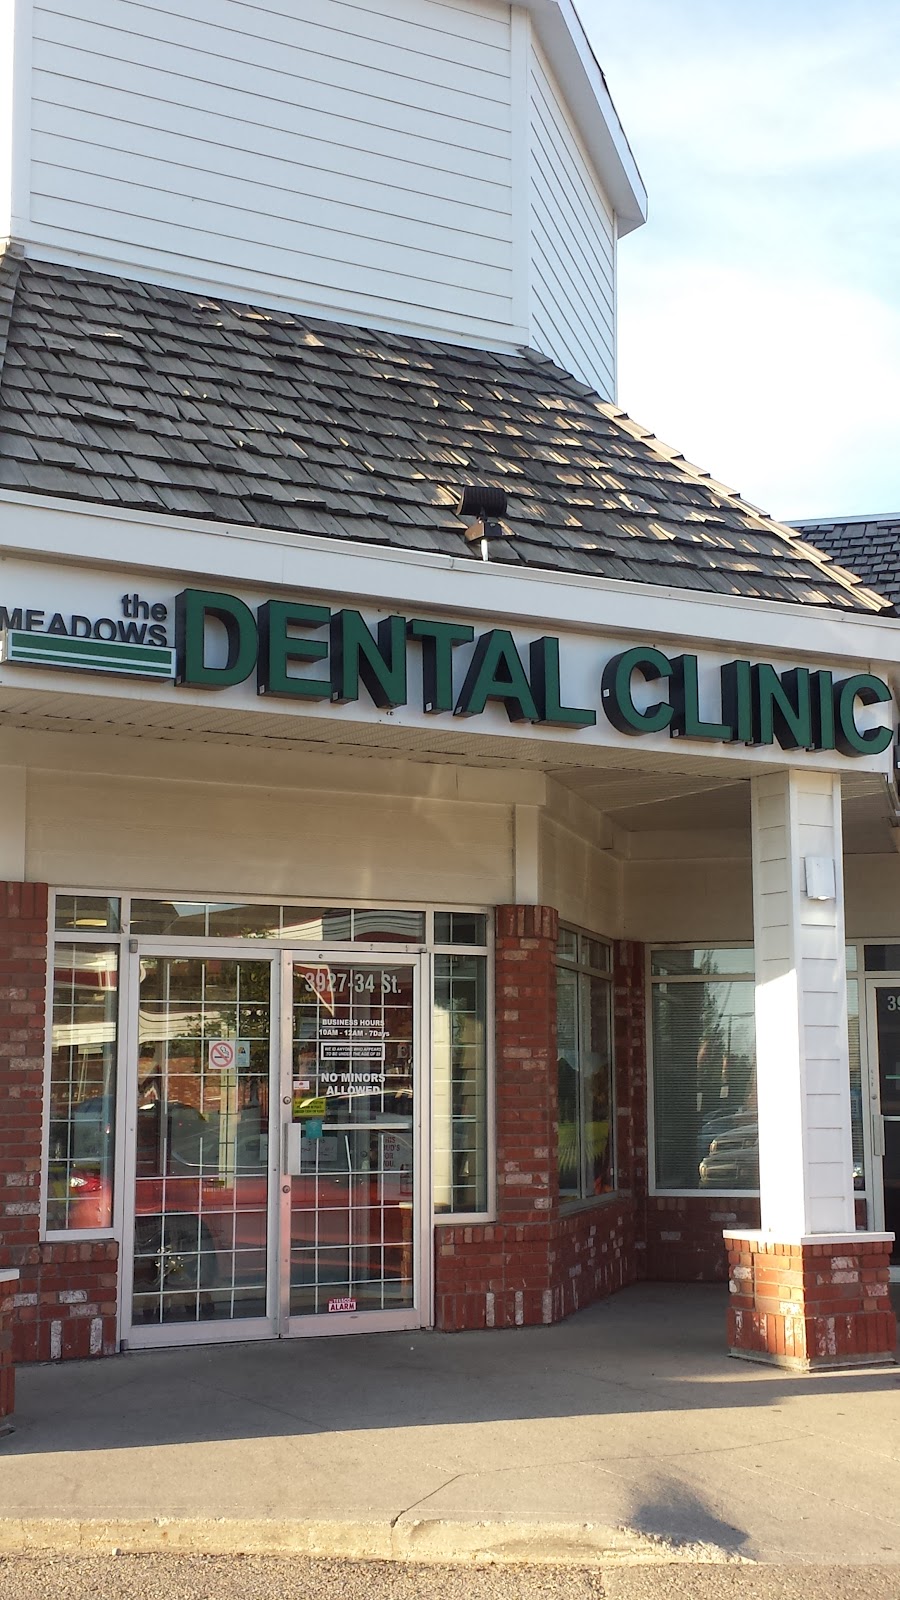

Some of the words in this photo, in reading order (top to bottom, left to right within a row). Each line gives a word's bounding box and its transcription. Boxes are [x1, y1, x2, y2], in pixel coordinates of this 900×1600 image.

[121, 593, 168, 622] the
[0, 605, 168, 647] MEADOWS
[175, 588, 596, 729] DENTAL
[602, 647, 893, 757] CLINIC
[381, 973, 402, 993] St.
[322, 1018, 358, 1026] BUSINESS
[319, 1028, 338, 1036] 10AM
[321, 1072, 338, 1082] NO
[341, 1072, 386, 1083] MINORS
[326, 1086, 380, 1095] ALLOWED
[330, 1303, 355, 1311] ALARM
